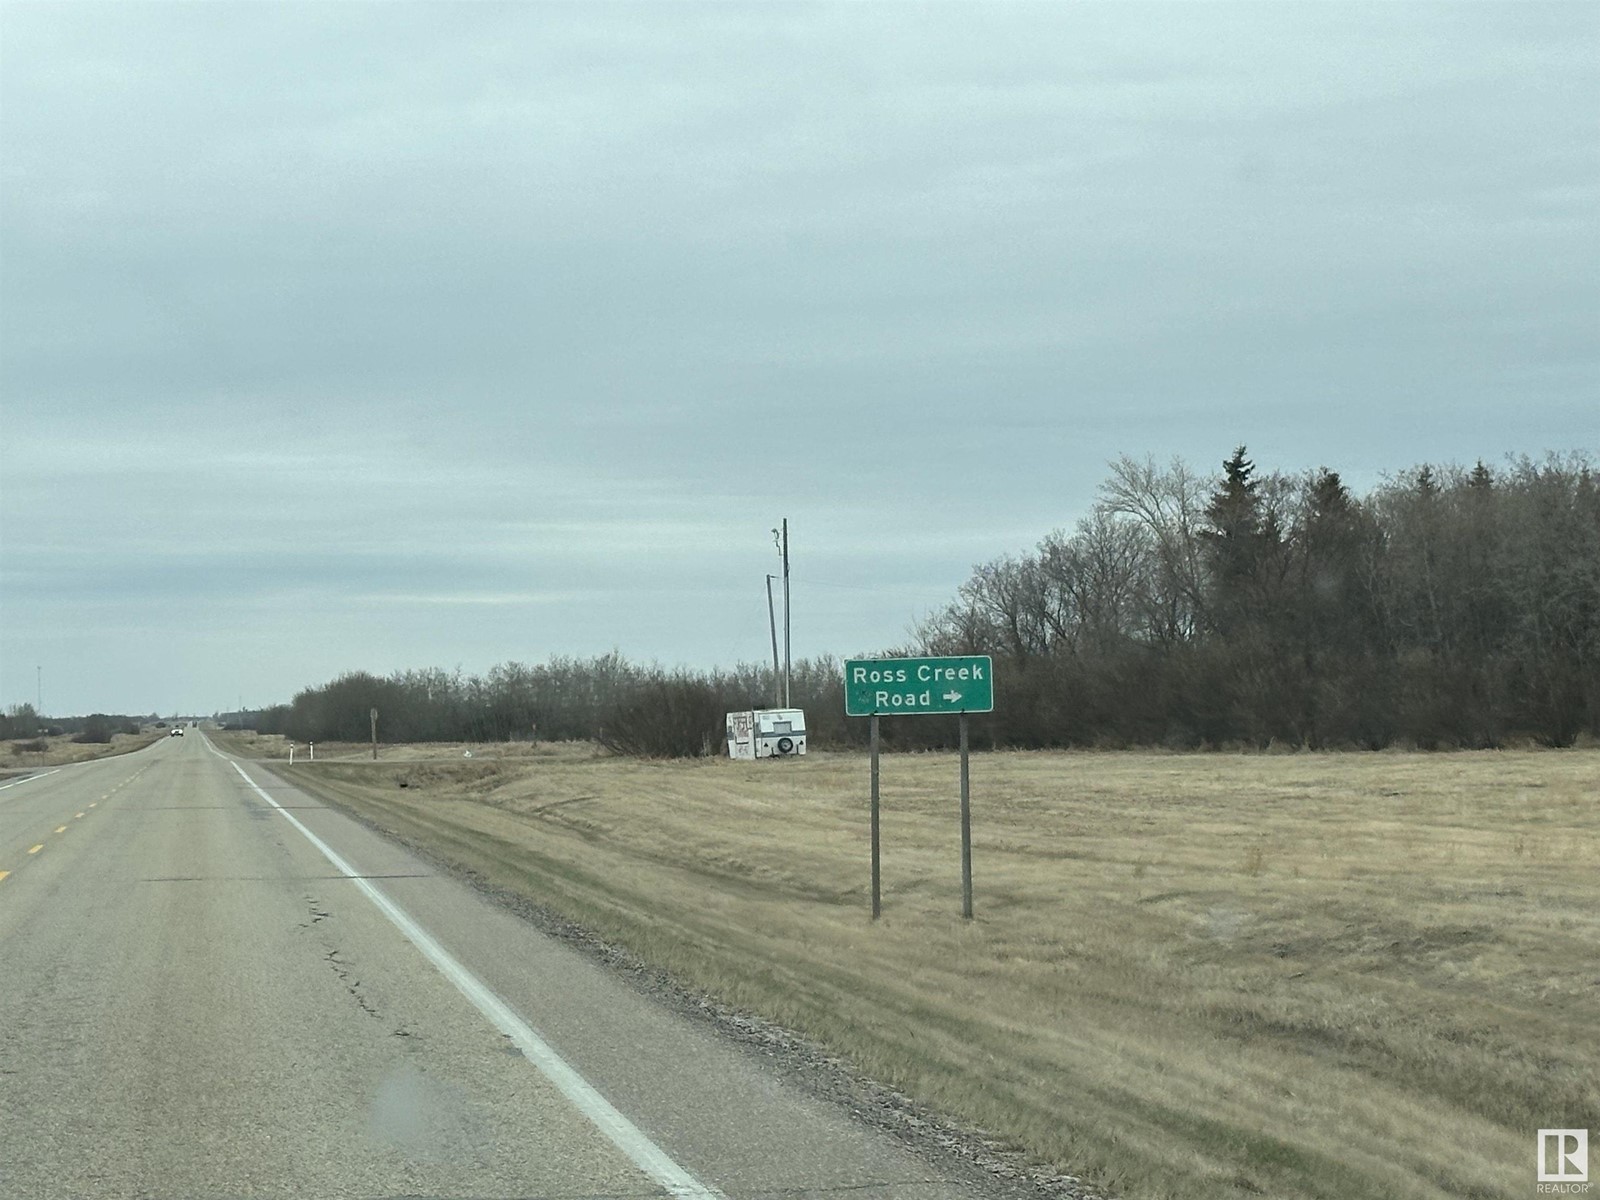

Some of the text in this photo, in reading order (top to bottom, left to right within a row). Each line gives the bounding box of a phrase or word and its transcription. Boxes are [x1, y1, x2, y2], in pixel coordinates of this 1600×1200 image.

[853, 664, 983, 684] Ross Creek
[876, 690, 930, 708] Road
